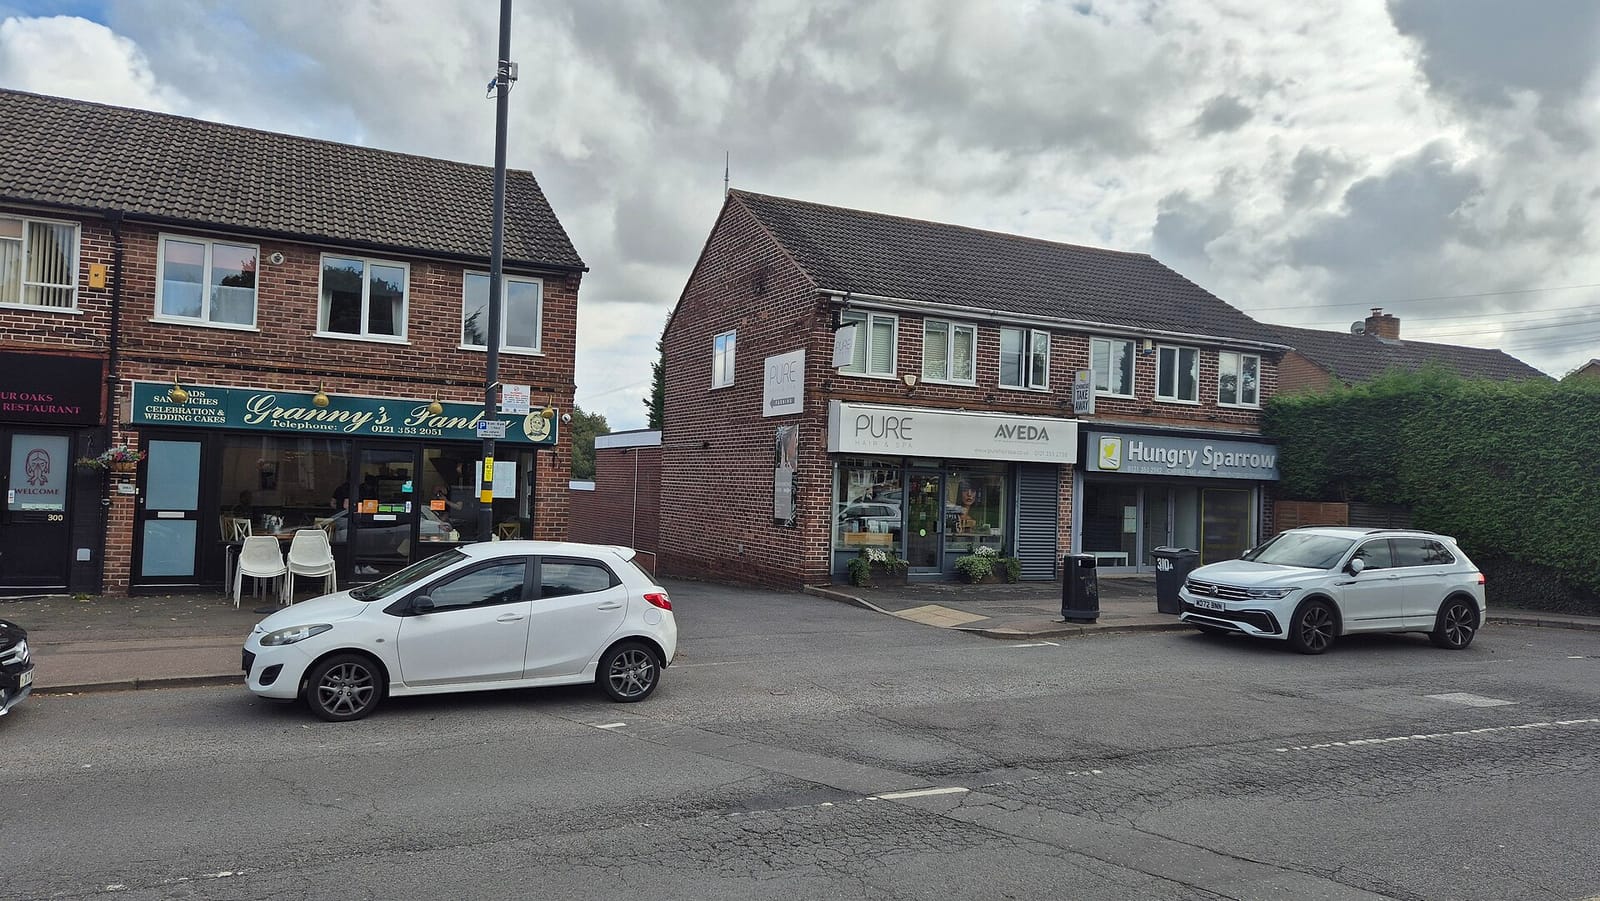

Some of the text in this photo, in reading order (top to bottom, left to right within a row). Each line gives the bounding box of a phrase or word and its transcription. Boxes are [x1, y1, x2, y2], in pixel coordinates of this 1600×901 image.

[770, 361, 797, 385] PURE
[20, 393, 54, 402] OAKS
[168, 388, 206, 398] SADS
[1076, 390, 1088, 400] TAKE
[153, 395, 219, 406] SANICHES
[1075, 400, 1088, 410] AWAY
[3, 403, 81, 414] RESTAURANT
[145, 405, 225, 417] CELEBRATION &
[244, 394, 517, 432] Granny's Pant
[144, 412, 226, 424] WEDDING CAKES
[271, 419, 442, 436] Telephone: 0121 353 2051
[855, 414, 913, 440] PURE
[994, 424, 1049, 440] AVEDA
[1128, 441, 1275, 471] Hungry Sparrow
[15, 488, 59, 496] WELCOME
